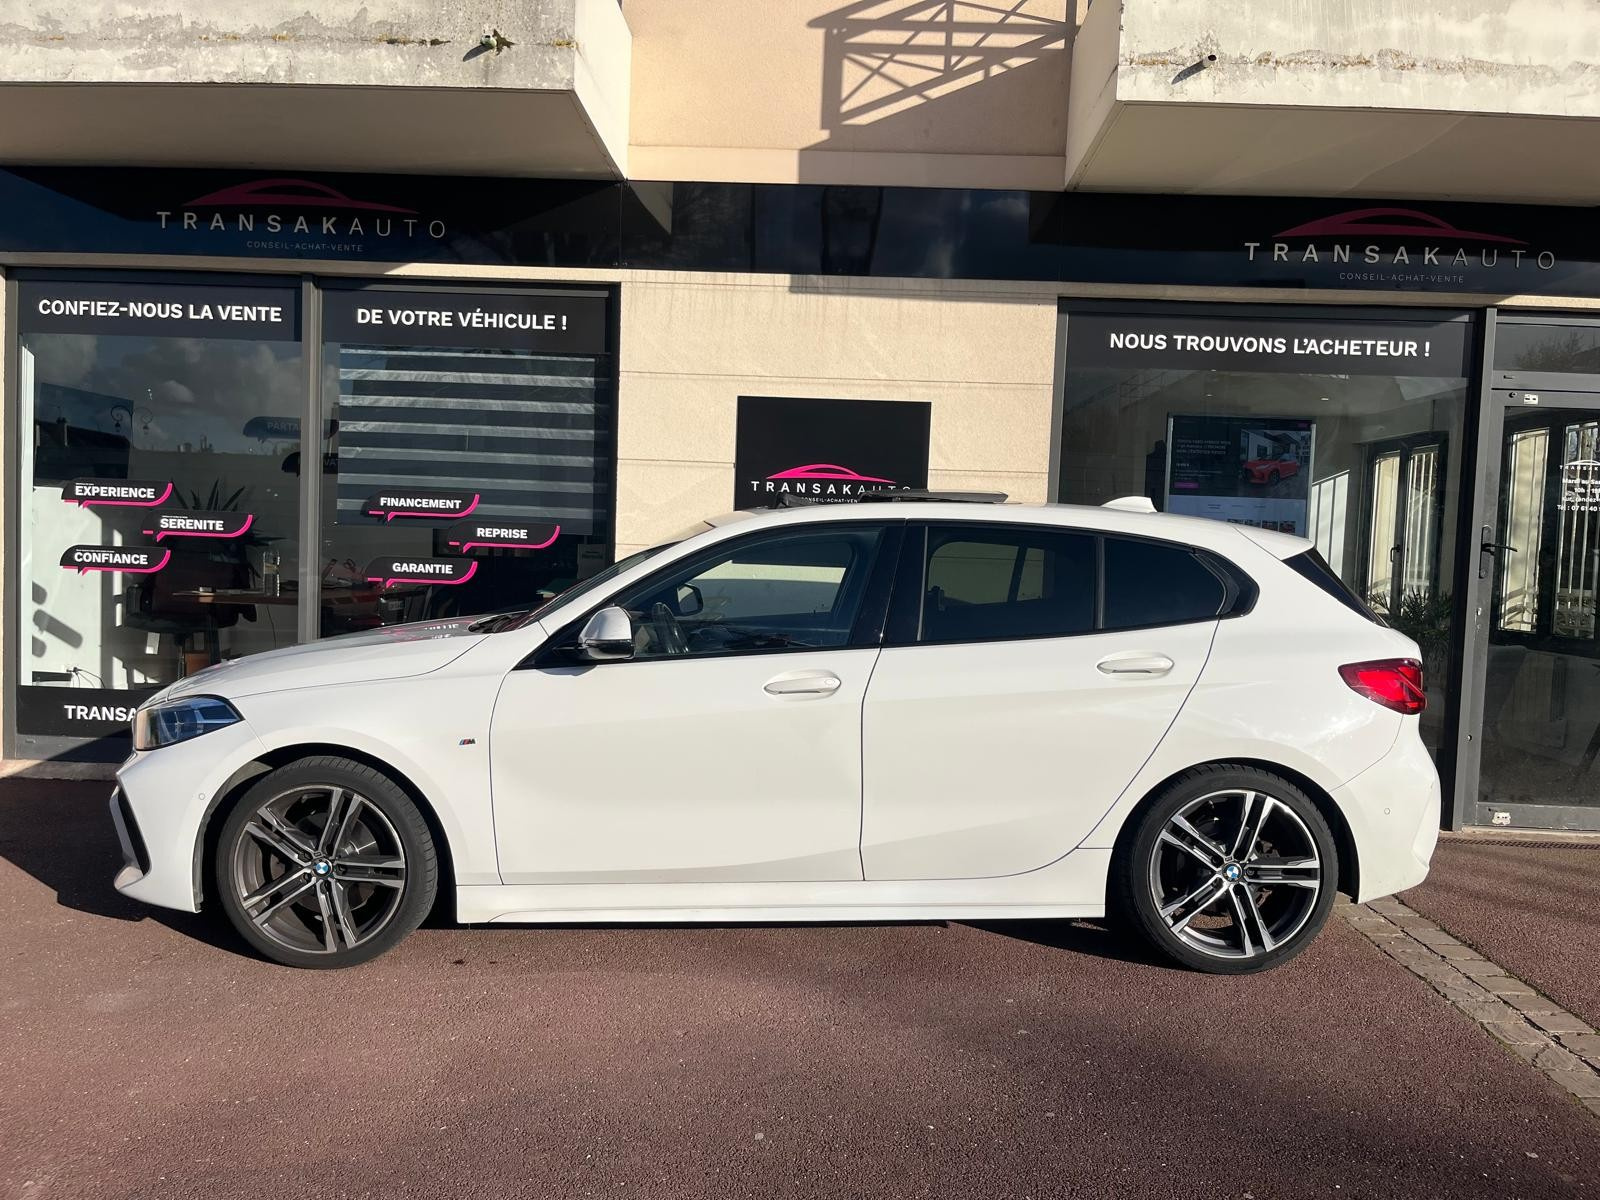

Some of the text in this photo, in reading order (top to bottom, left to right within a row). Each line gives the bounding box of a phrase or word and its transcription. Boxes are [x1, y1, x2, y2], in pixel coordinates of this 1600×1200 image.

[156, 211, 446, 239] TRANSAKAUTO
[246, 240, 363, 252] CONSEIL-ACHAT-VENTE
[1244, 242, 1556, 270] TRANSAKAUTO
[1339, 272, 1465, 284] CONSEIL-ACHAT-VENTE
[38, 299, 282, 322] CONFIEZ-NOUS LA VENTE
[357, 308, 567, 330] DE VOTRE VÉHICULE !
[1109, 333, 1431, 357] NOUS TROUVONS L'ACHETEUR !
[75, 485, 155, 499] EXPERIENCE
[380, 497, 462, 509] FINANCEMENT
[160, 518, 224, 531] SERENITE
[476, 527, 528, 539] REPRISE
[74, 552, 148, 565] CONFIANCE
[392, 562, 453, 574] GARANTIE
